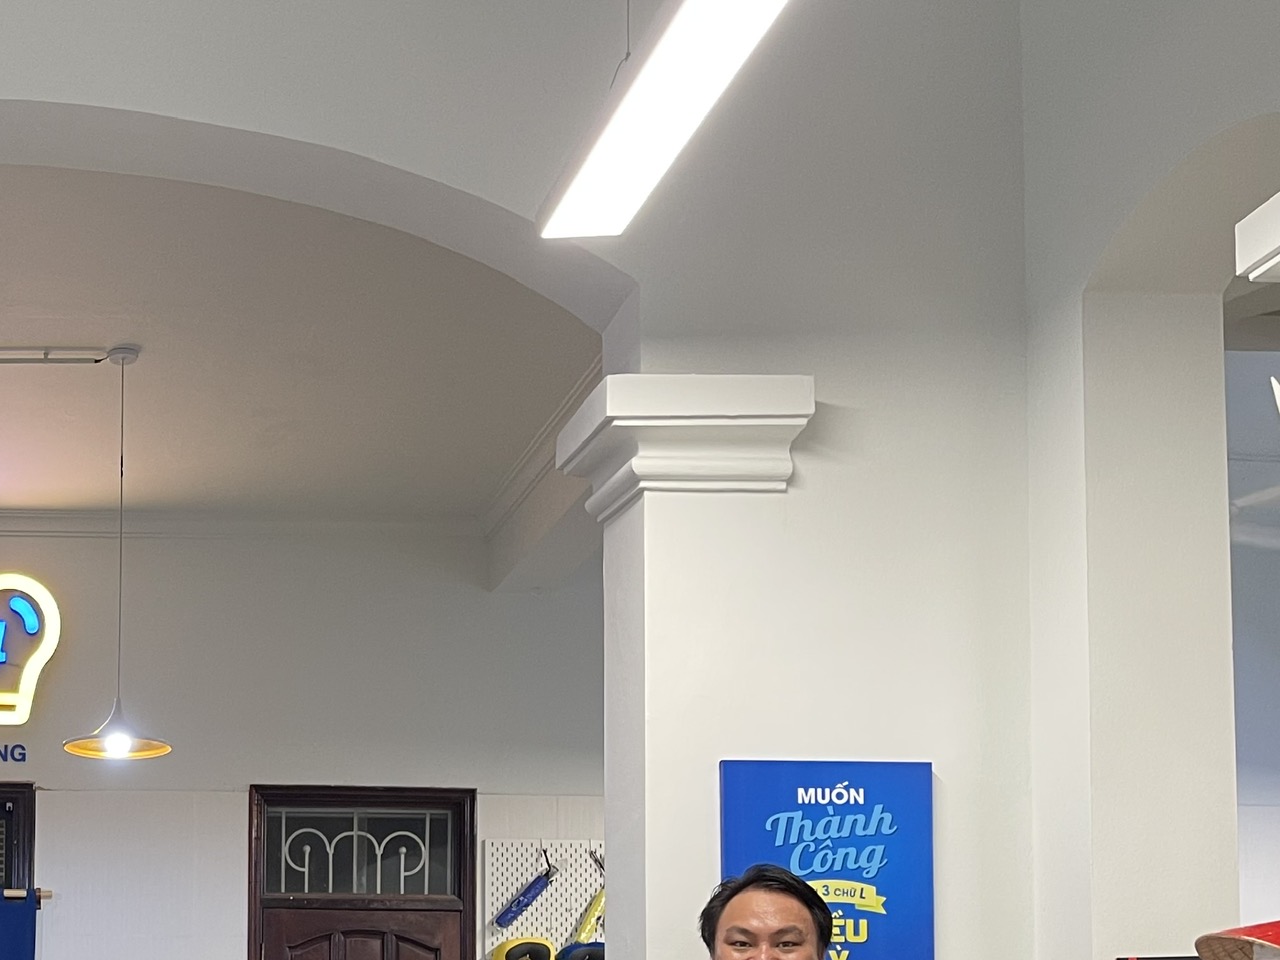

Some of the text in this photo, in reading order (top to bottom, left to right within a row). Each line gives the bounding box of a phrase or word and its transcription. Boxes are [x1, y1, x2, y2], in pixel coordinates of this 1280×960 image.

[797, 781, 864, 805] MUỐN
[765, 804, 898, 847] Thành
[789, 838, 888, 878] Công
[822, 885, 866, 899] 3 CHỮ L
[830, 909, 868, 943] ỀU
